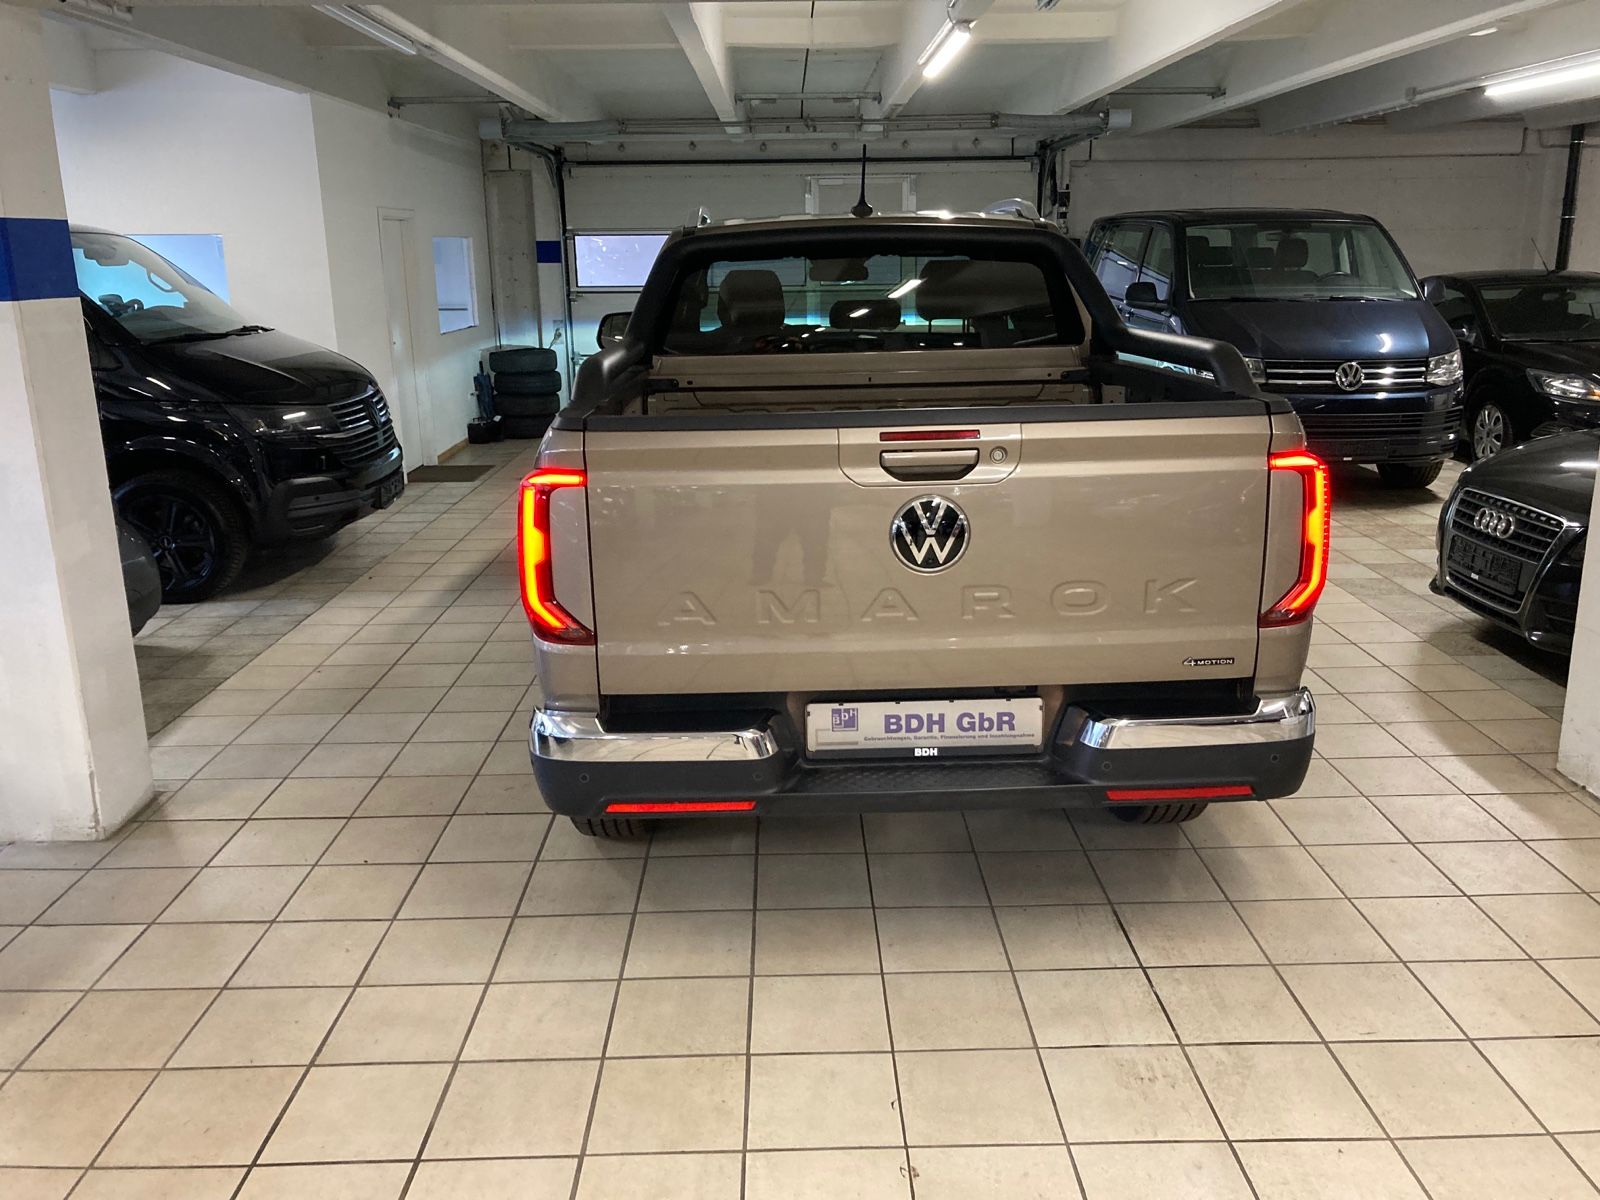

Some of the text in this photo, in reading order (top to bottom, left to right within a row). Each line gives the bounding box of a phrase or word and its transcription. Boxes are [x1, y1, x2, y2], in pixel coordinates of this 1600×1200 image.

[893, 498, 967, 568] VW
[656, 577, 1200, 625] AMAROK
[1182, 657, 1233, 667] 4MOTION
[884, 712, 1015, 734] BDH GbR
[914, 748, 938, 757] BDH
